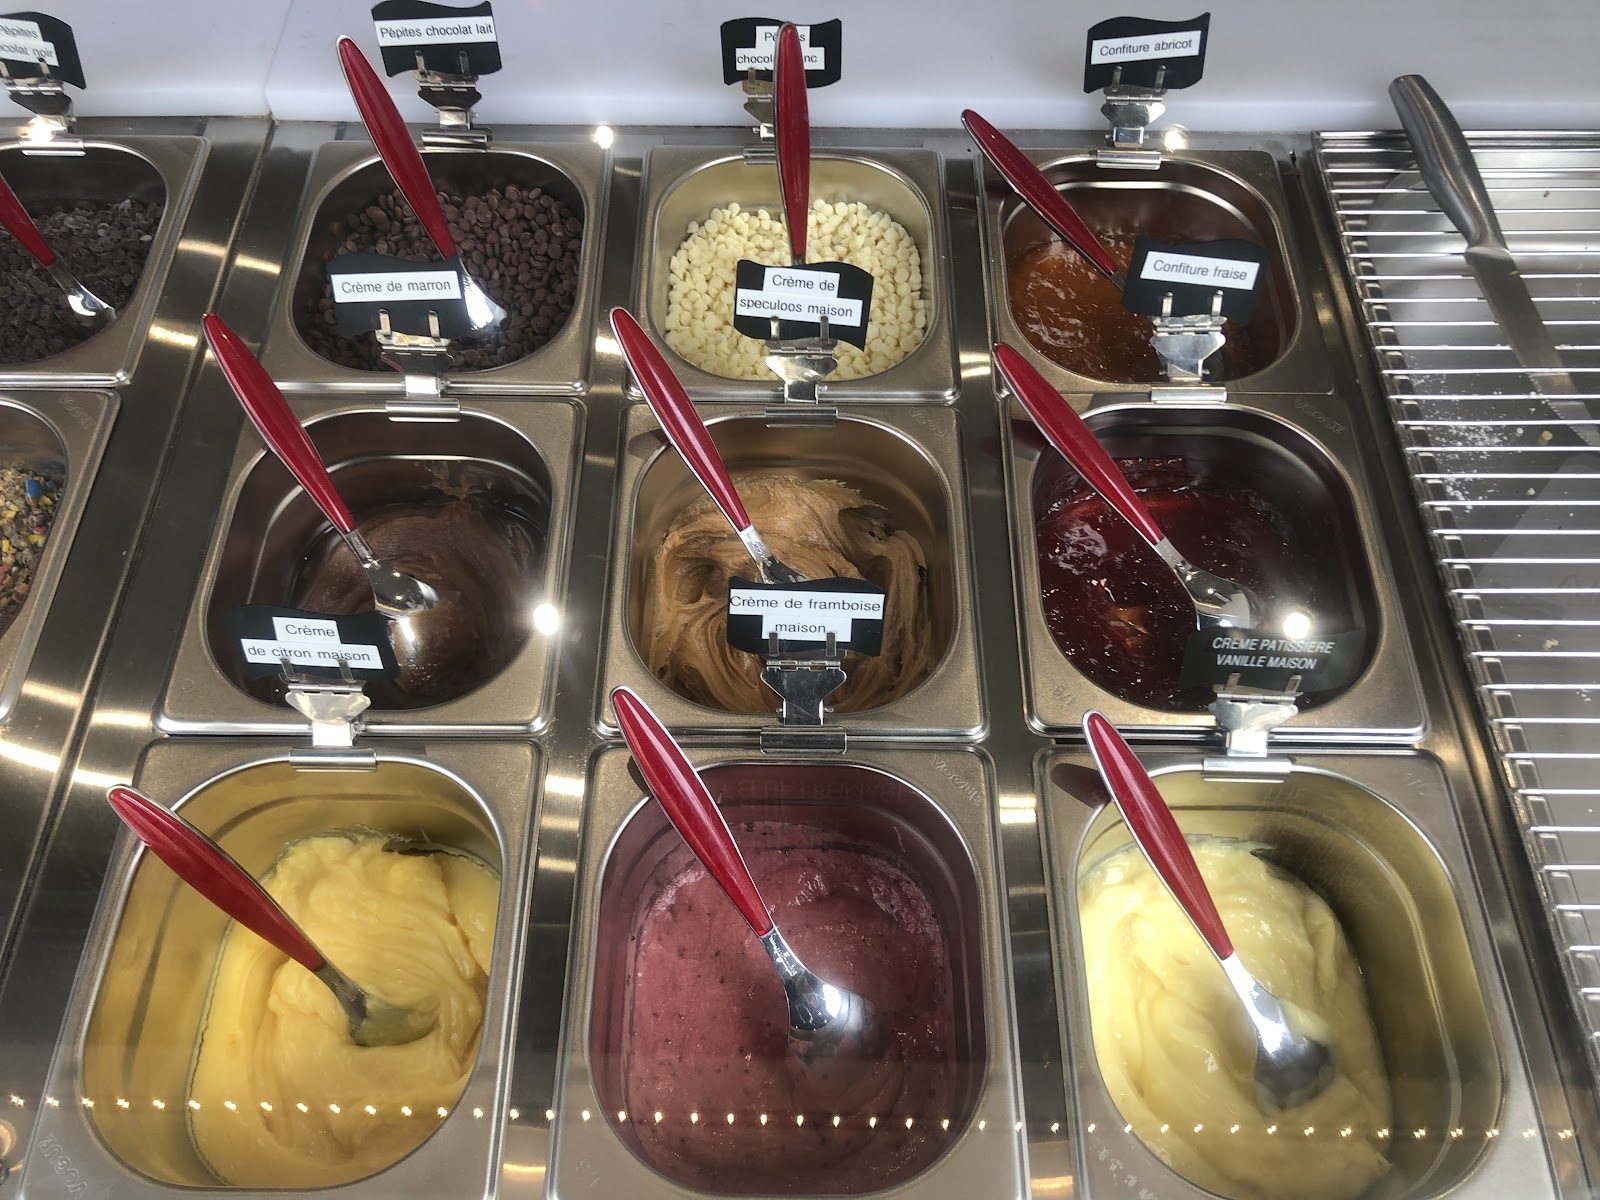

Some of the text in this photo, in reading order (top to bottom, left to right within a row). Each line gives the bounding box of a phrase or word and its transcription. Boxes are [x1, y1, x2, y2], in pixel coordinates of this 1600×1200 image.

[380, 23, 493, 39] Pépites chocolat lait
[33, 47, 53, 59] noir
[1100, 39, 1193, 56] Confiture abricot
[736, 54, 773, 64] chocol
[1153, 259, 1248, 280] Confiture fraise
[341, 280, 451, 293] Crème de marron
[772, 274, 835, 291] Crème de
[739, 298, 853, 317] speculoos maison
[730, 595, 881, 612] Crème de framboise
[285, 624, 336, 637] Crème
[775, 622, 826, 633] maison
[248, 645, 371, 661] de citron maison
[1212, 637, 1336, 654] CREME PATISSIERE
[1216, 653, 1318, 670] VANILLE MAISON
